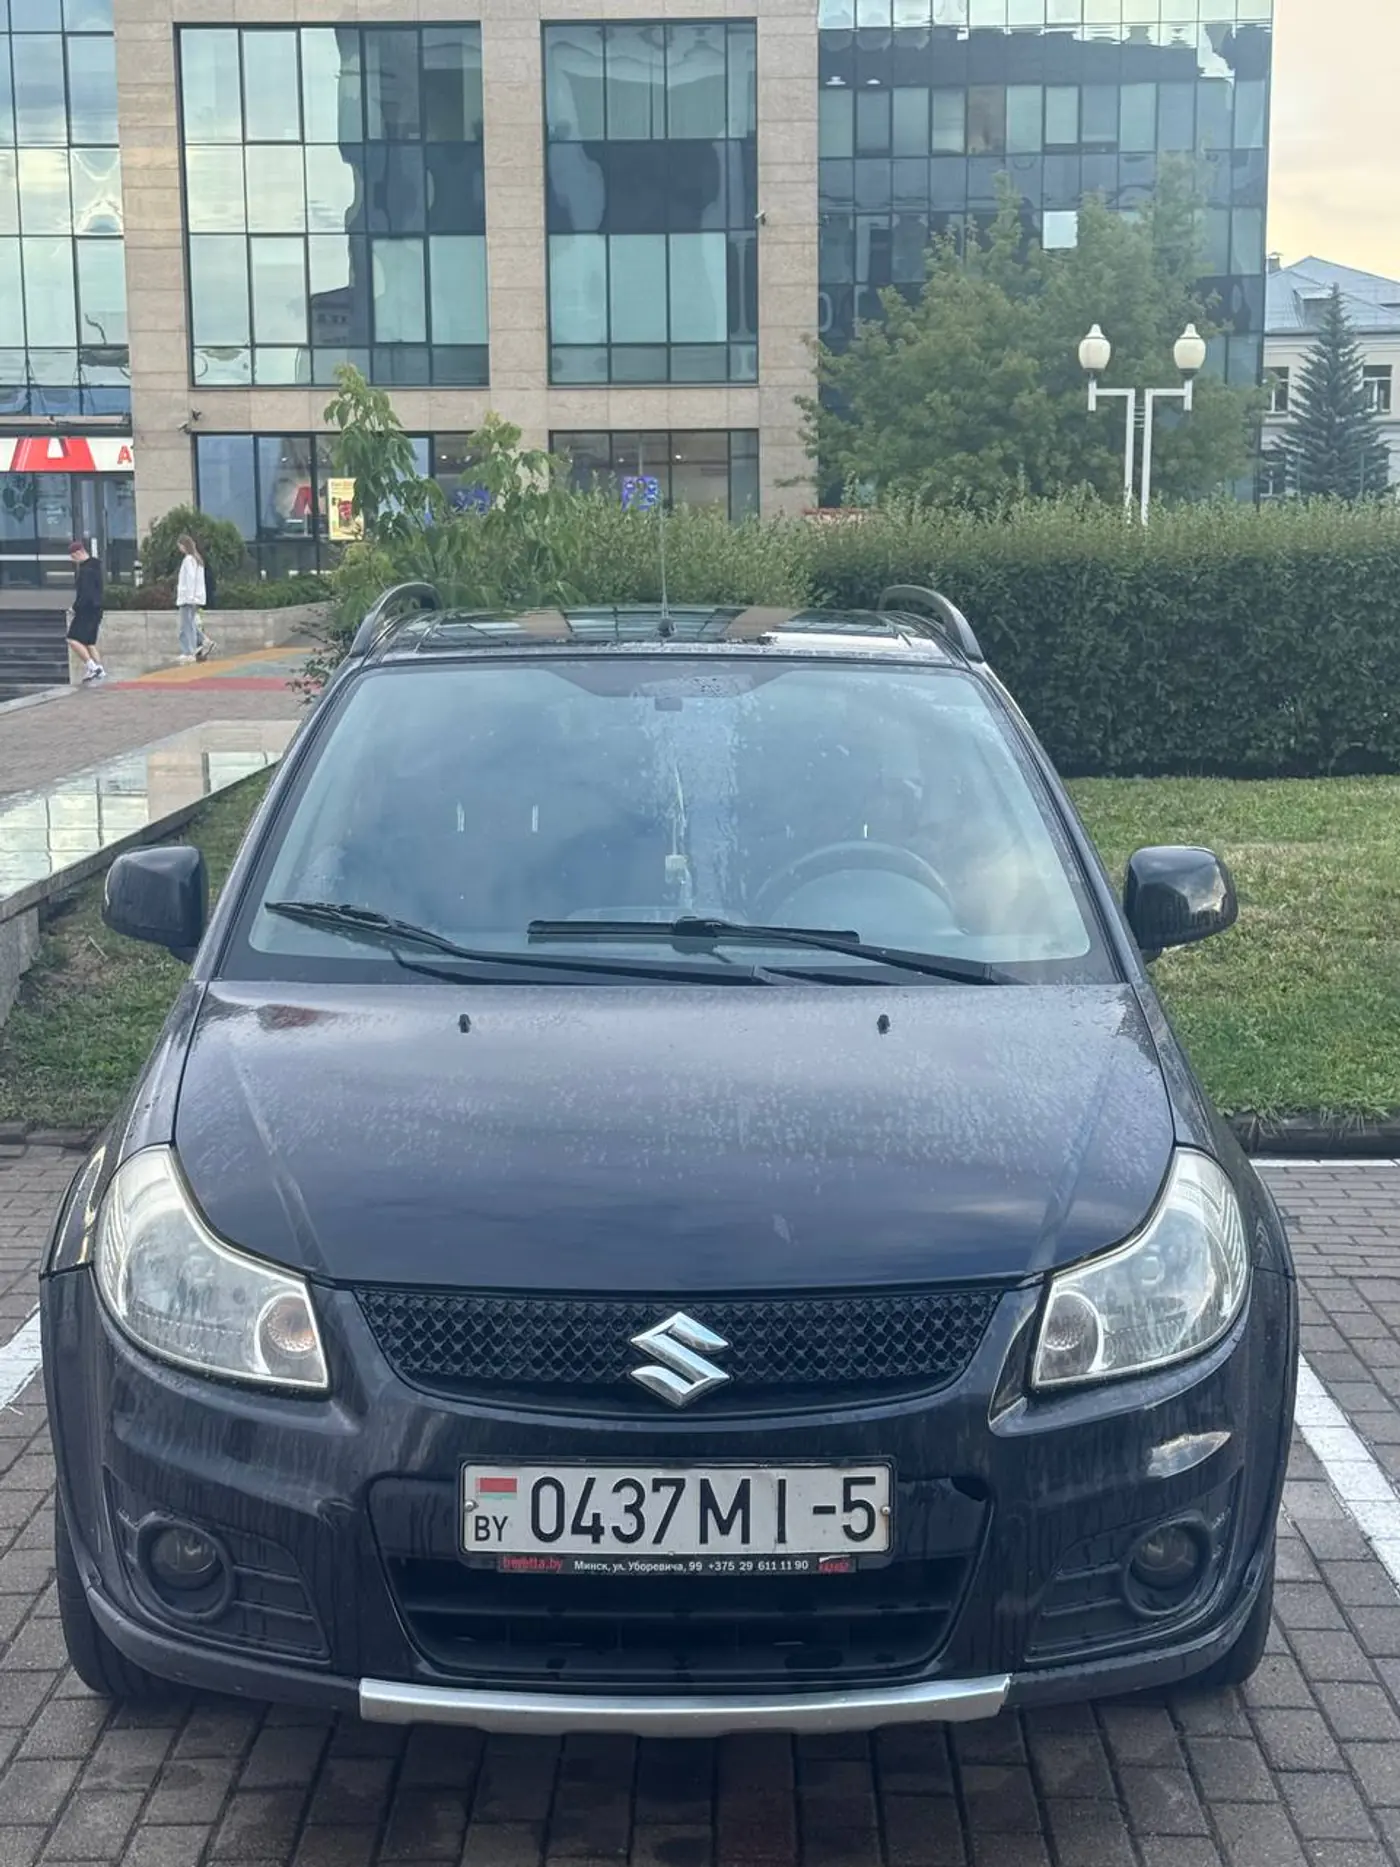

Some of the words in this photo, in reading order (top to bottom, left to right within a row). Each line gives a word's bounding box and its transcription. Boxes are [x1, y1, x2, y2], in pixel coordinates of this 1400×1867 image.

[474, 1515, 508, 1542] BY
[574, 1560, 610, 1572] Минск,
[628, 1560, 686, 1573] Уборевича,
[688, 1561, 702, 1571] 99
[708, 1561, 735, 1571] +375
[739, 1561, 753, 1571] 29
[758, 1560, 777, 1571] 611
